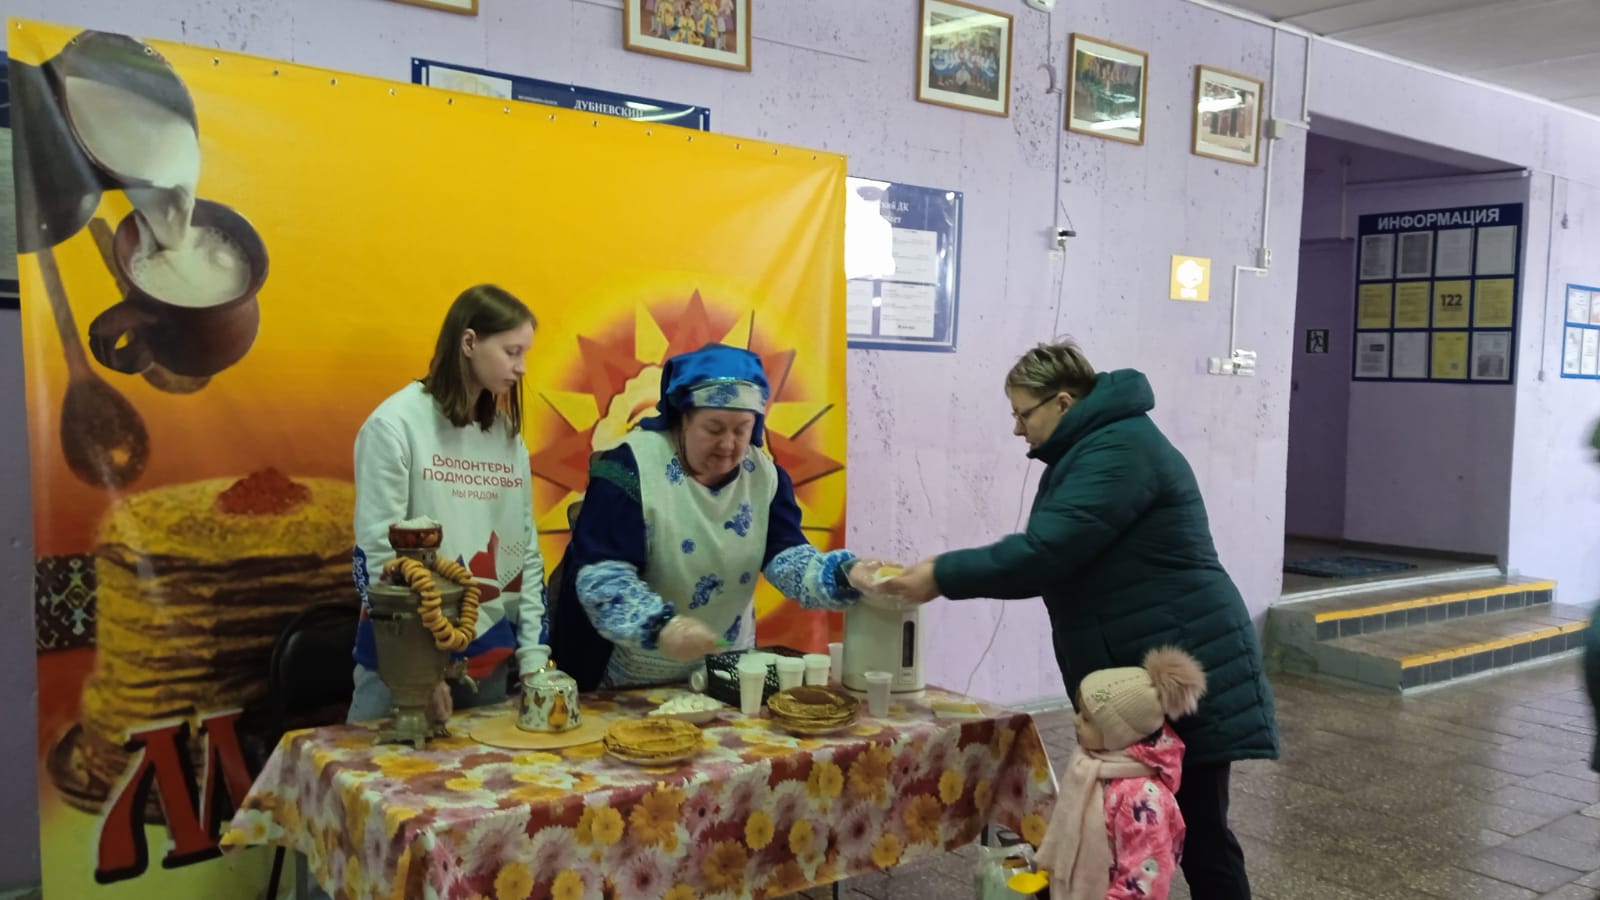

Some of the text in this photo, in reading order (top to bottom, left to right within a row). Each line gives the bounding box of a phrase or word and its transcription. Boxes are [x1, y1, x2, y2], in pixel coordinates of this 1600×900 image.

[1377, 207, 1500, 231] ИНФОРМАЦИЯ
[1440, 294, 1463, 307] 122
[452, 489, 499, 501] МЫ РЯДОМ
